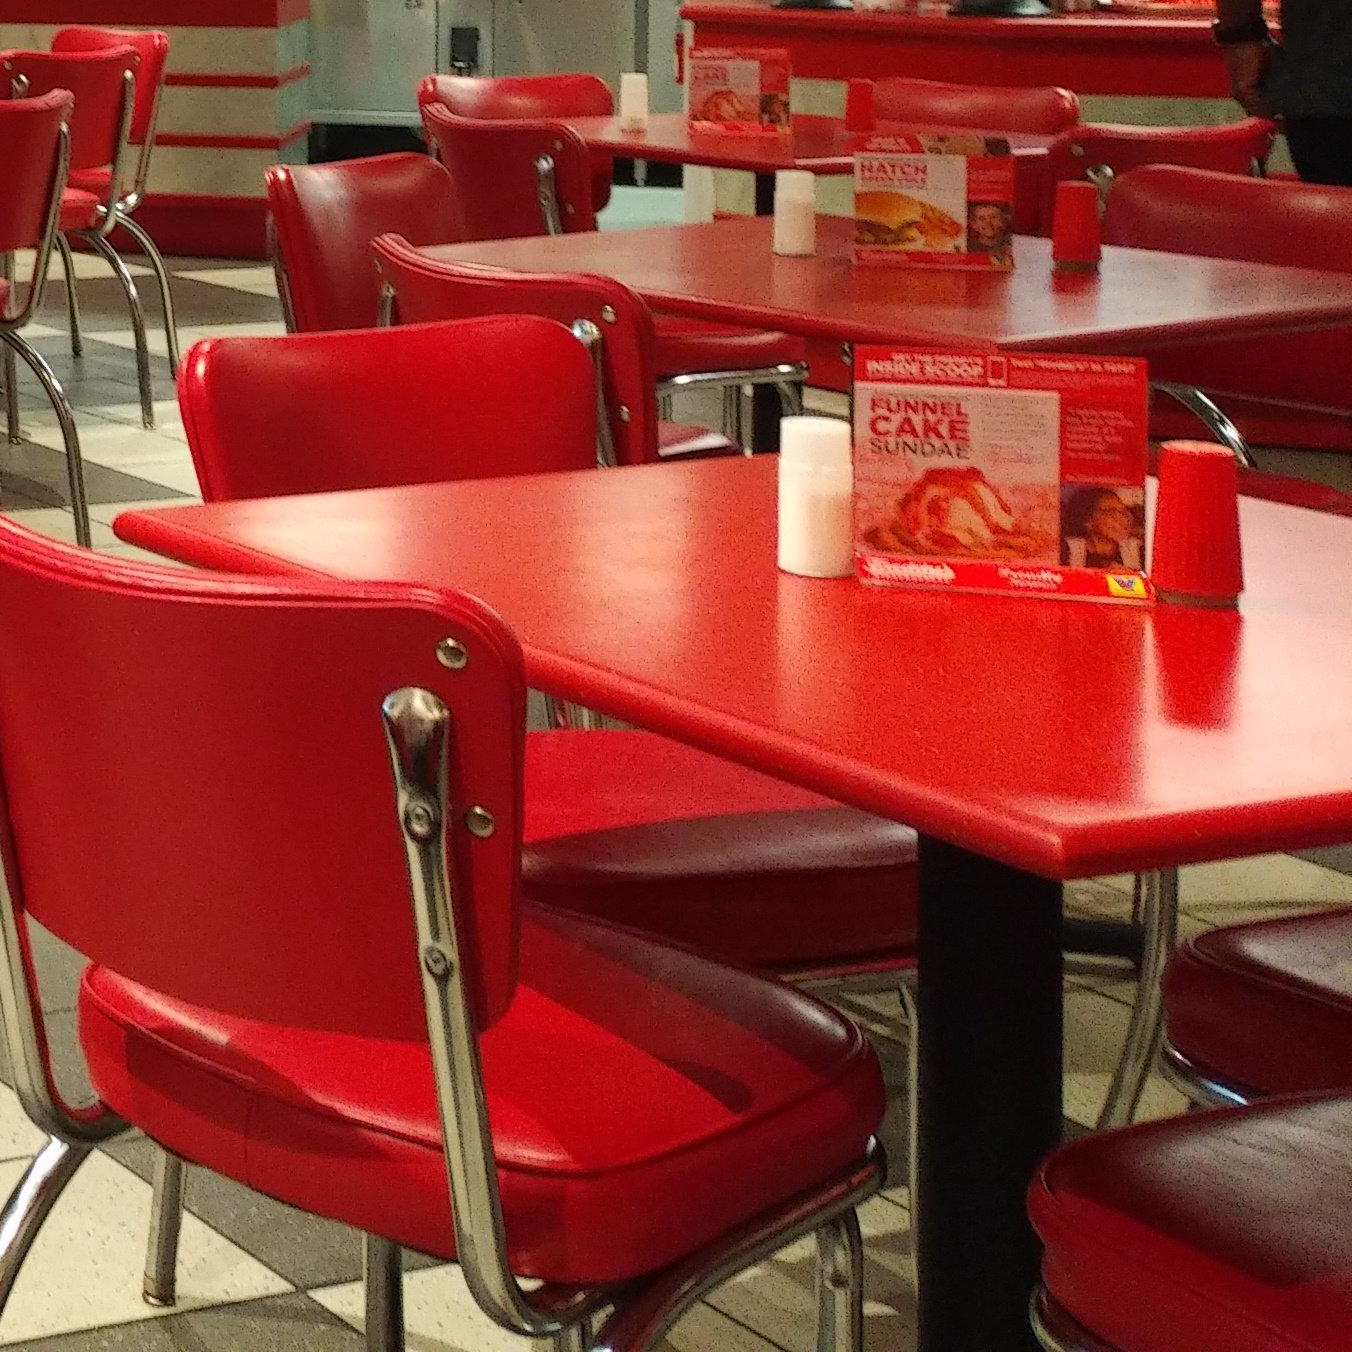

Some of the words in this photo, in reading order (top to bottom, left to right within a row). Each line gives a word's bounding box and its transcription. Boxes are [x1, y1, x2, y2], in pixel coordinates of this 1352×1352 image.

[870, 397, 969, 417] FUNNEL
[870, 415, 970, 441] CAKE
[869, 437, 970, 460] SUNDAE
